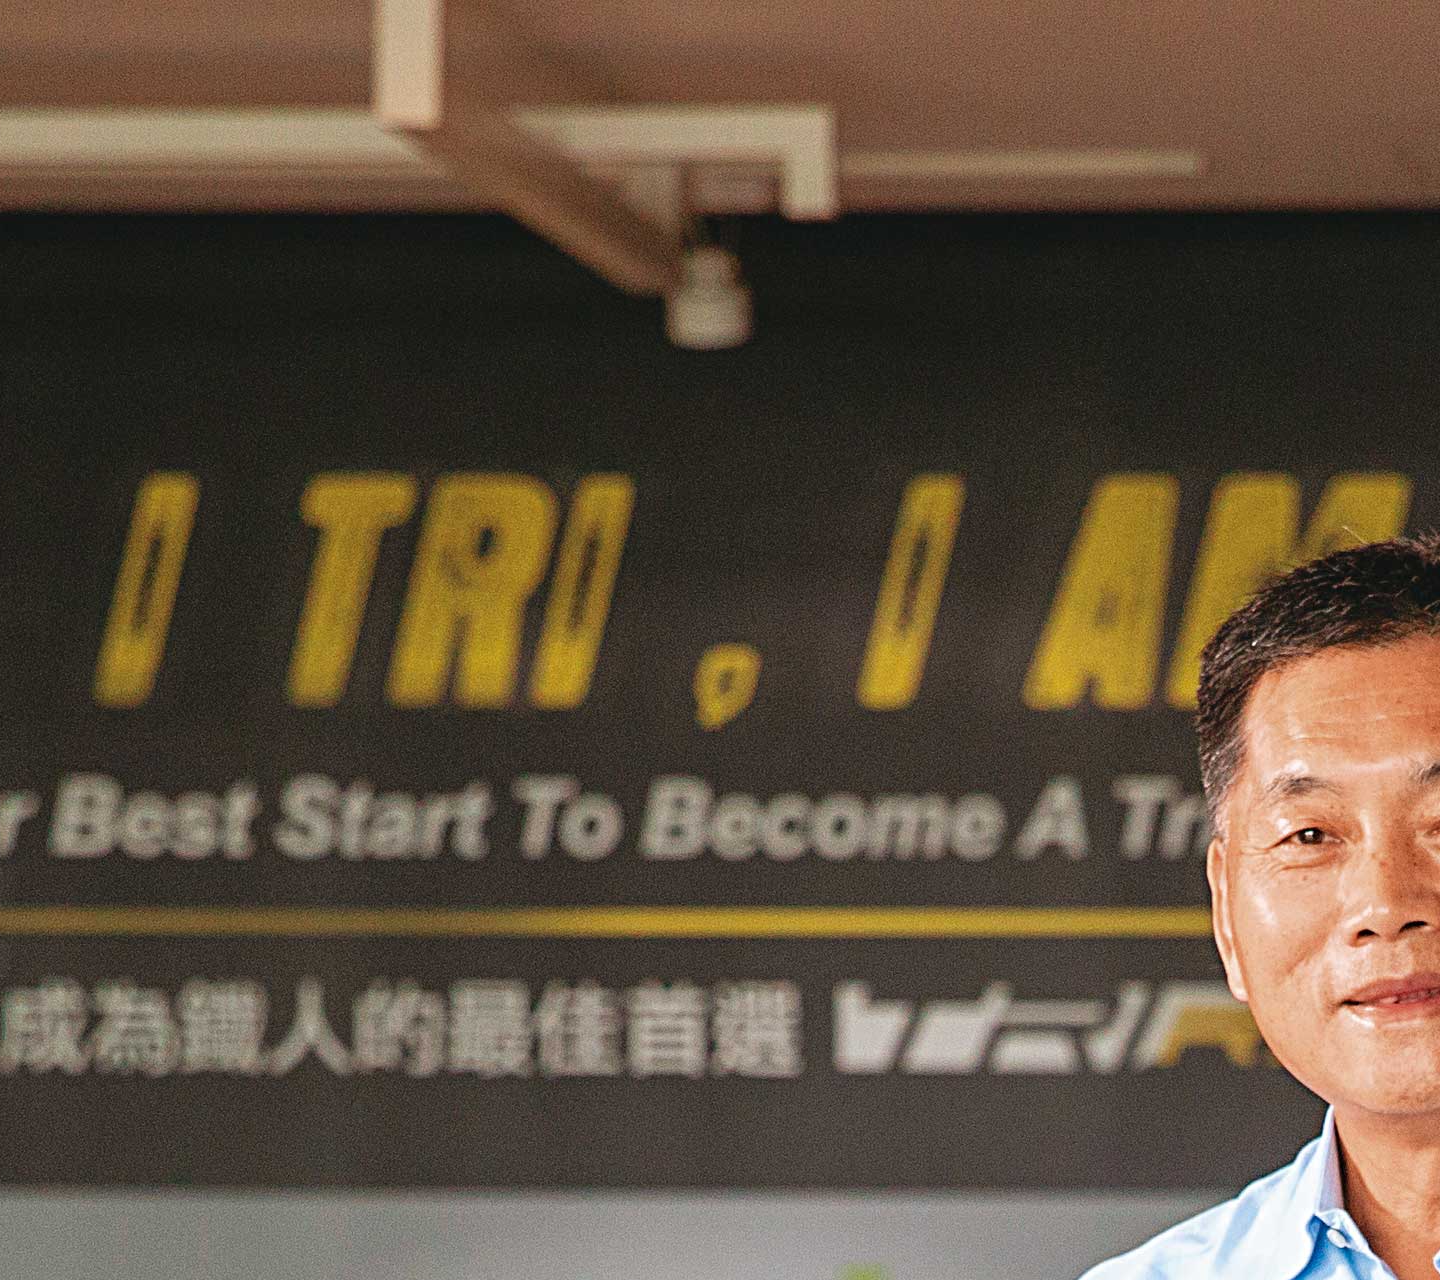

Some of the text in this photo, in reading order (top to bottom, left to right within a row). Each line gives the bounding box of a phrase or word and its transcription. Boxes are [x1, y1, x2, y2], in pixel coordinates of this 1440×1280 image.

[91, 469, 202, 710] I
[859, 471, 965, 711] I
[50, 772, 258, 860] Best
[274, 772, 491, 860] Start
[513, 773, 624, 860] To
[638, 774, 1007, 861] Become
[1012, 773, 1088, 860] A
